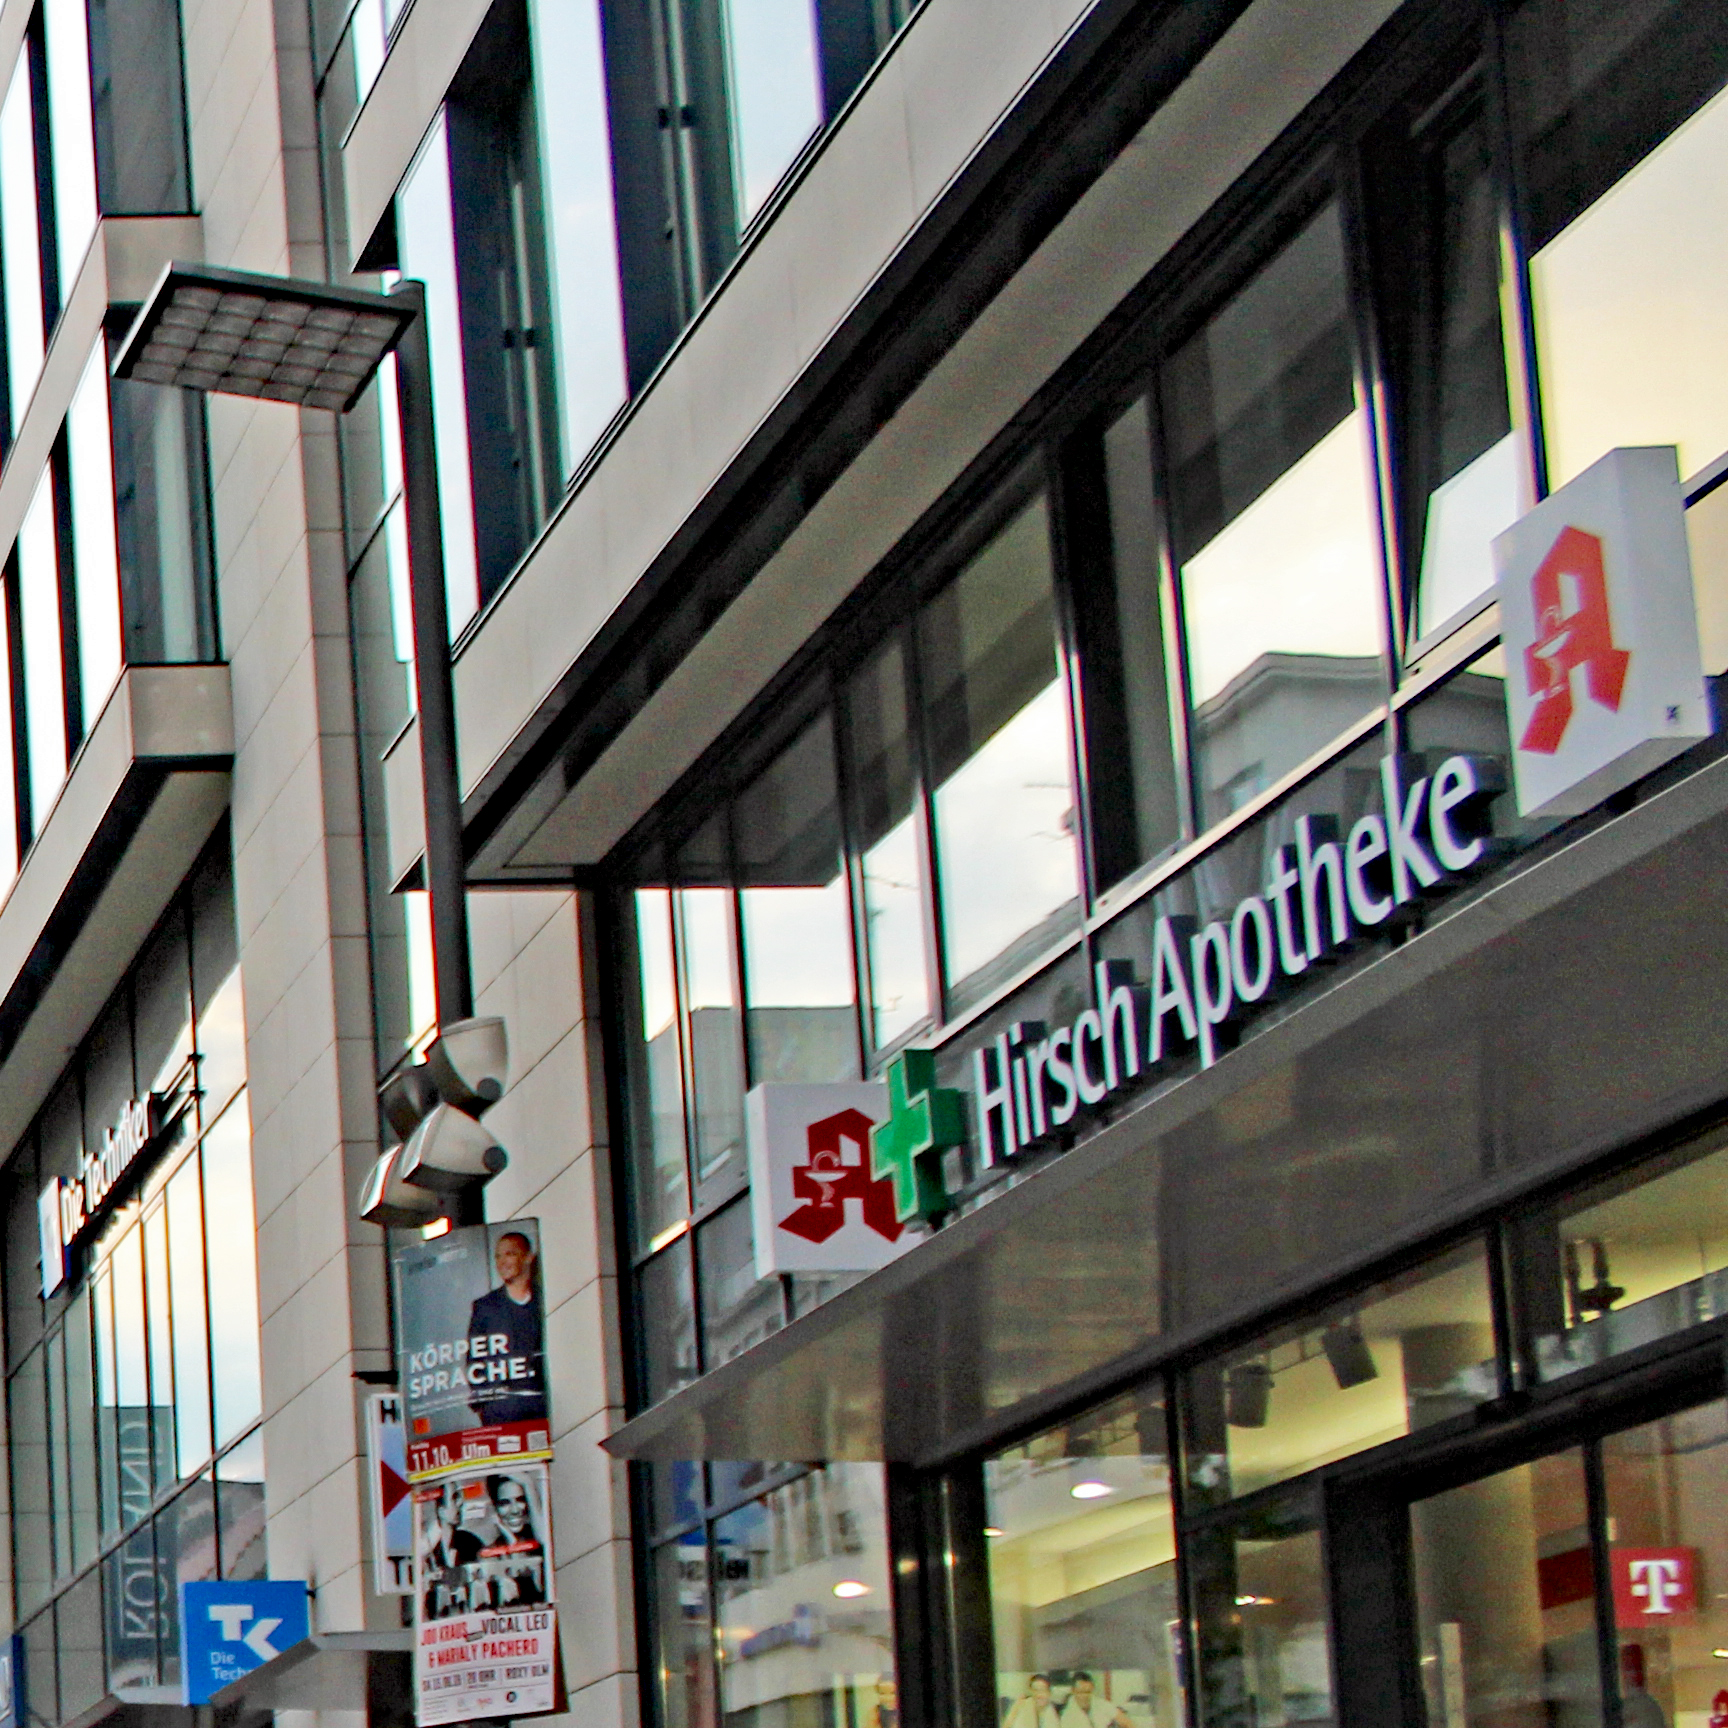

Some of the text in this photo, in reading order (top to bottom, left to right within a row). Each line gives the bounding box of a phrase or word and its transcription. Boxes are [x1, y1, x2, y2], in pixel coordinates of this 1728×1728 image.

[972, 750, 1486, 1170] Hirsch Apotheke
[60, 1177, 86, 1247] Die
[408, 1333, 510, 1374] KÖRPER
[408, 1357, 536, 1400] SPRACHE.
[211, 1651, 235, 1665] Die
